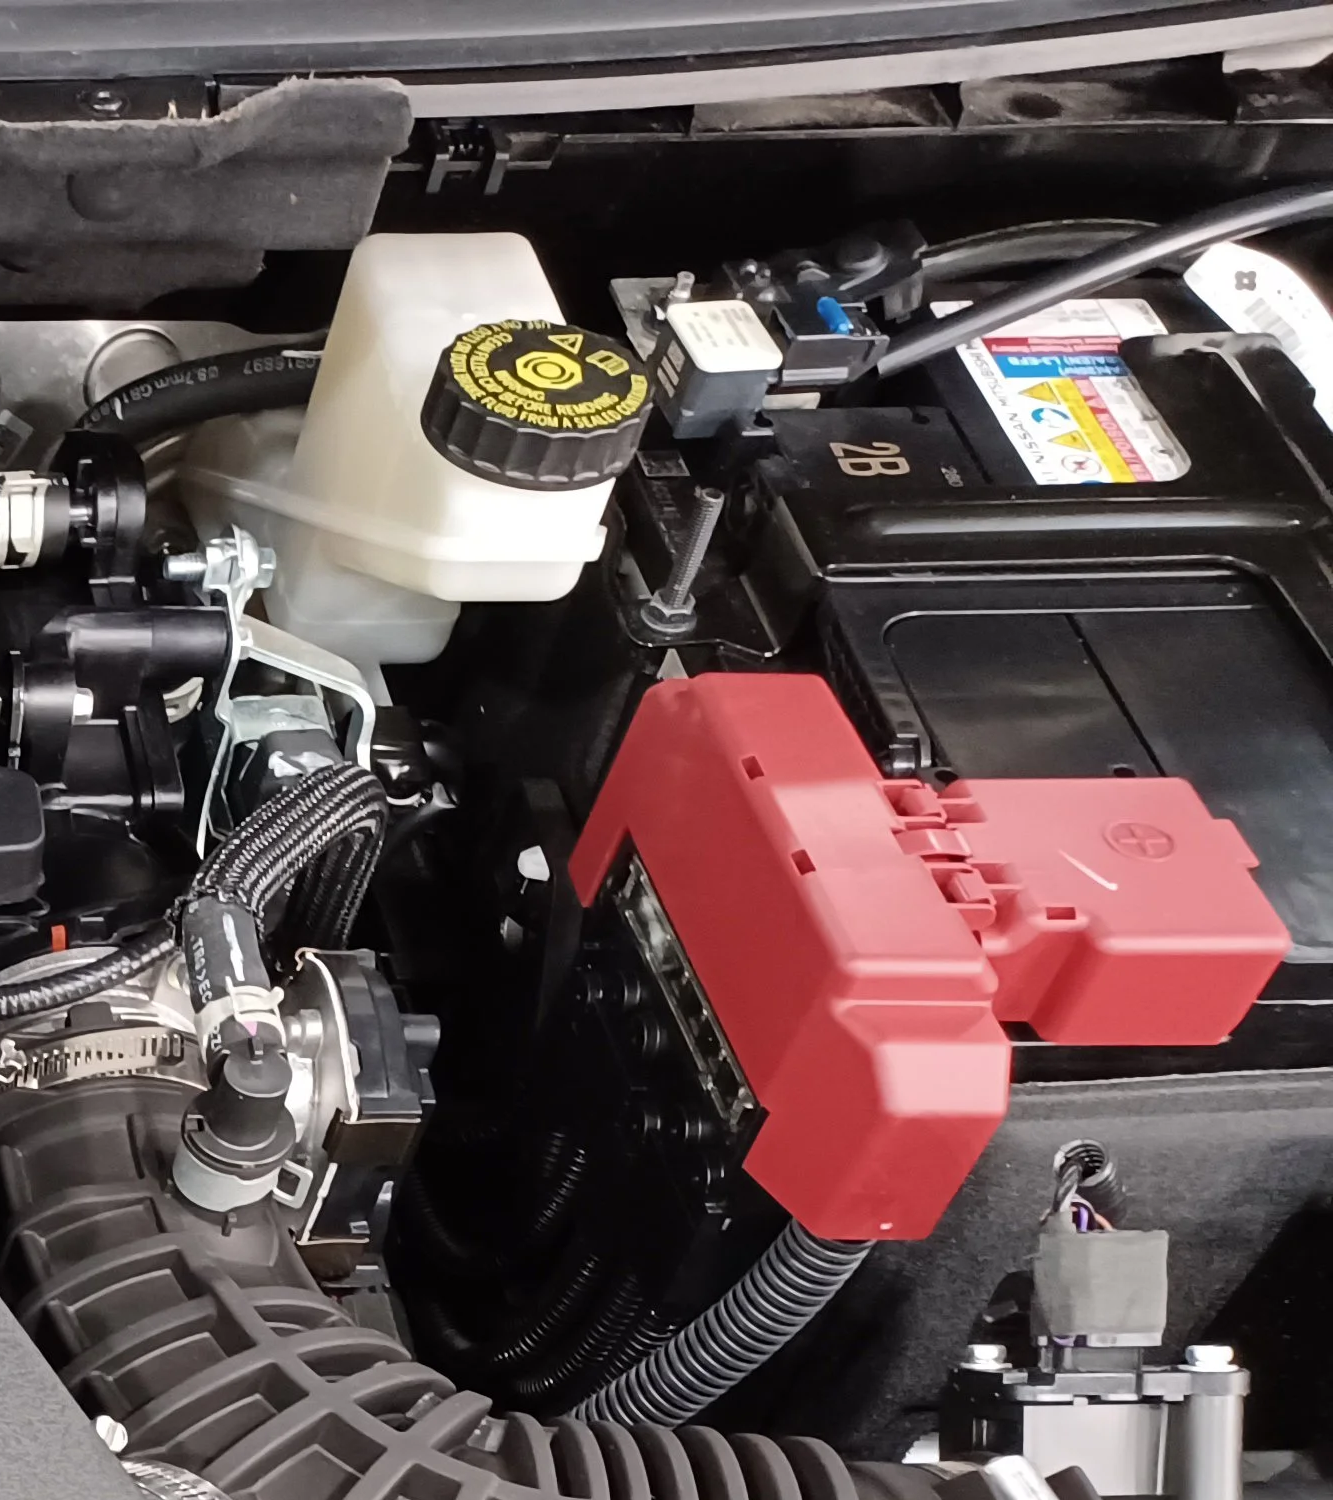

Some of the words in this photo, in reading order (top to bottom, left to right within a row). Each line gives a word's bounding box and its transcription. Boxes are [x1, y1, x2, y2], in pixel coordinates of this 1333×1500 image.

[966, 351, 1013, 406] MITSUBISHI
[481, 396, 519, 418] FLUID
[519, 411, 558, 427] FROM
[560, 416, 573, 428] A
[574, 409, 622, 429] SEALED
[499, 391, 552, 415] BEFORE
[556, 392, 619, 416] REMOVING
[1004, 412, 1048, 463] NISSAN
[830, 441, 907, 478] 2B
